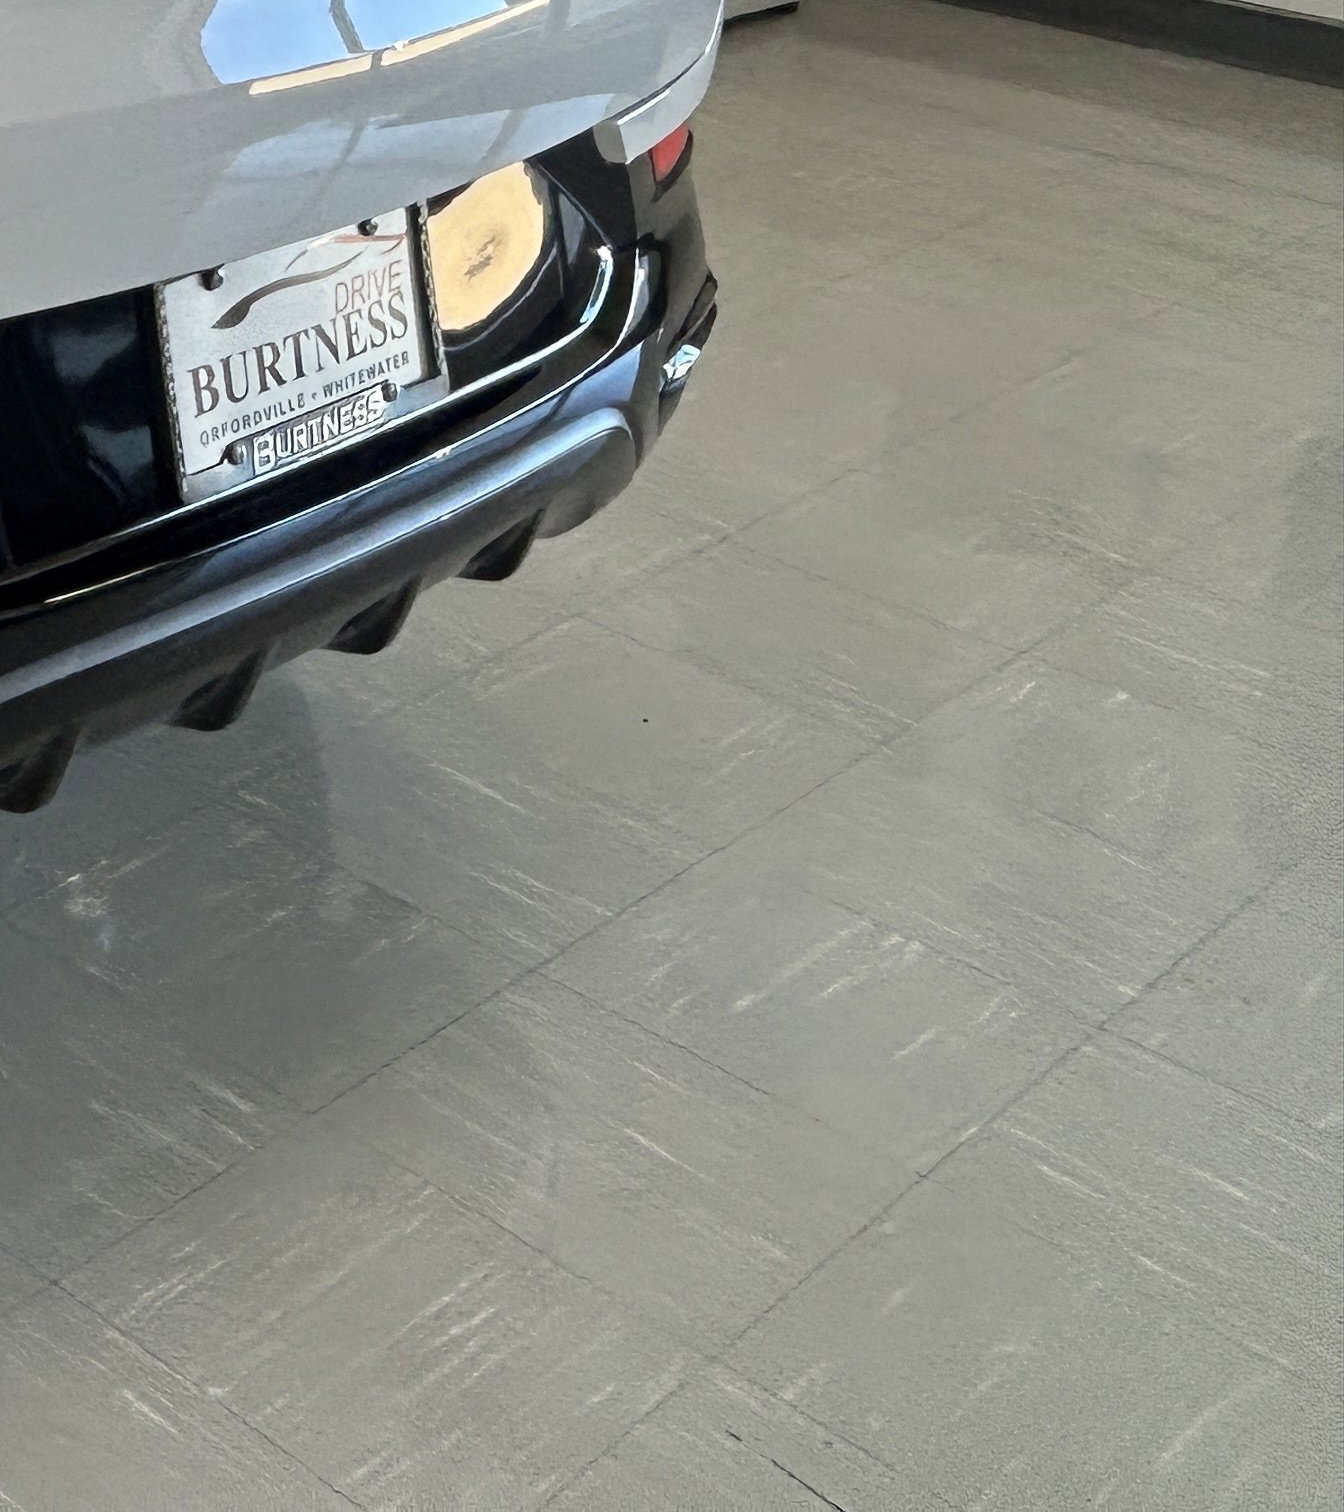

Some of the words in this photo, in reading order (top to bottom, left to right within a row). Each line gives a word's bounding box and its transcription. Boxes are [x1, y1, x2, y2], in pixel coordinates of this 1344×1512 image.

[334, 259, 404, 316] DRIVE
[185, 291, 409, 419] BURTNESS
[199, 391, 306, 448] ORFORDVILLE
[321, 350, 410, 400] WHITEWATER
[253, 388, 386, 475] BURTNESS
